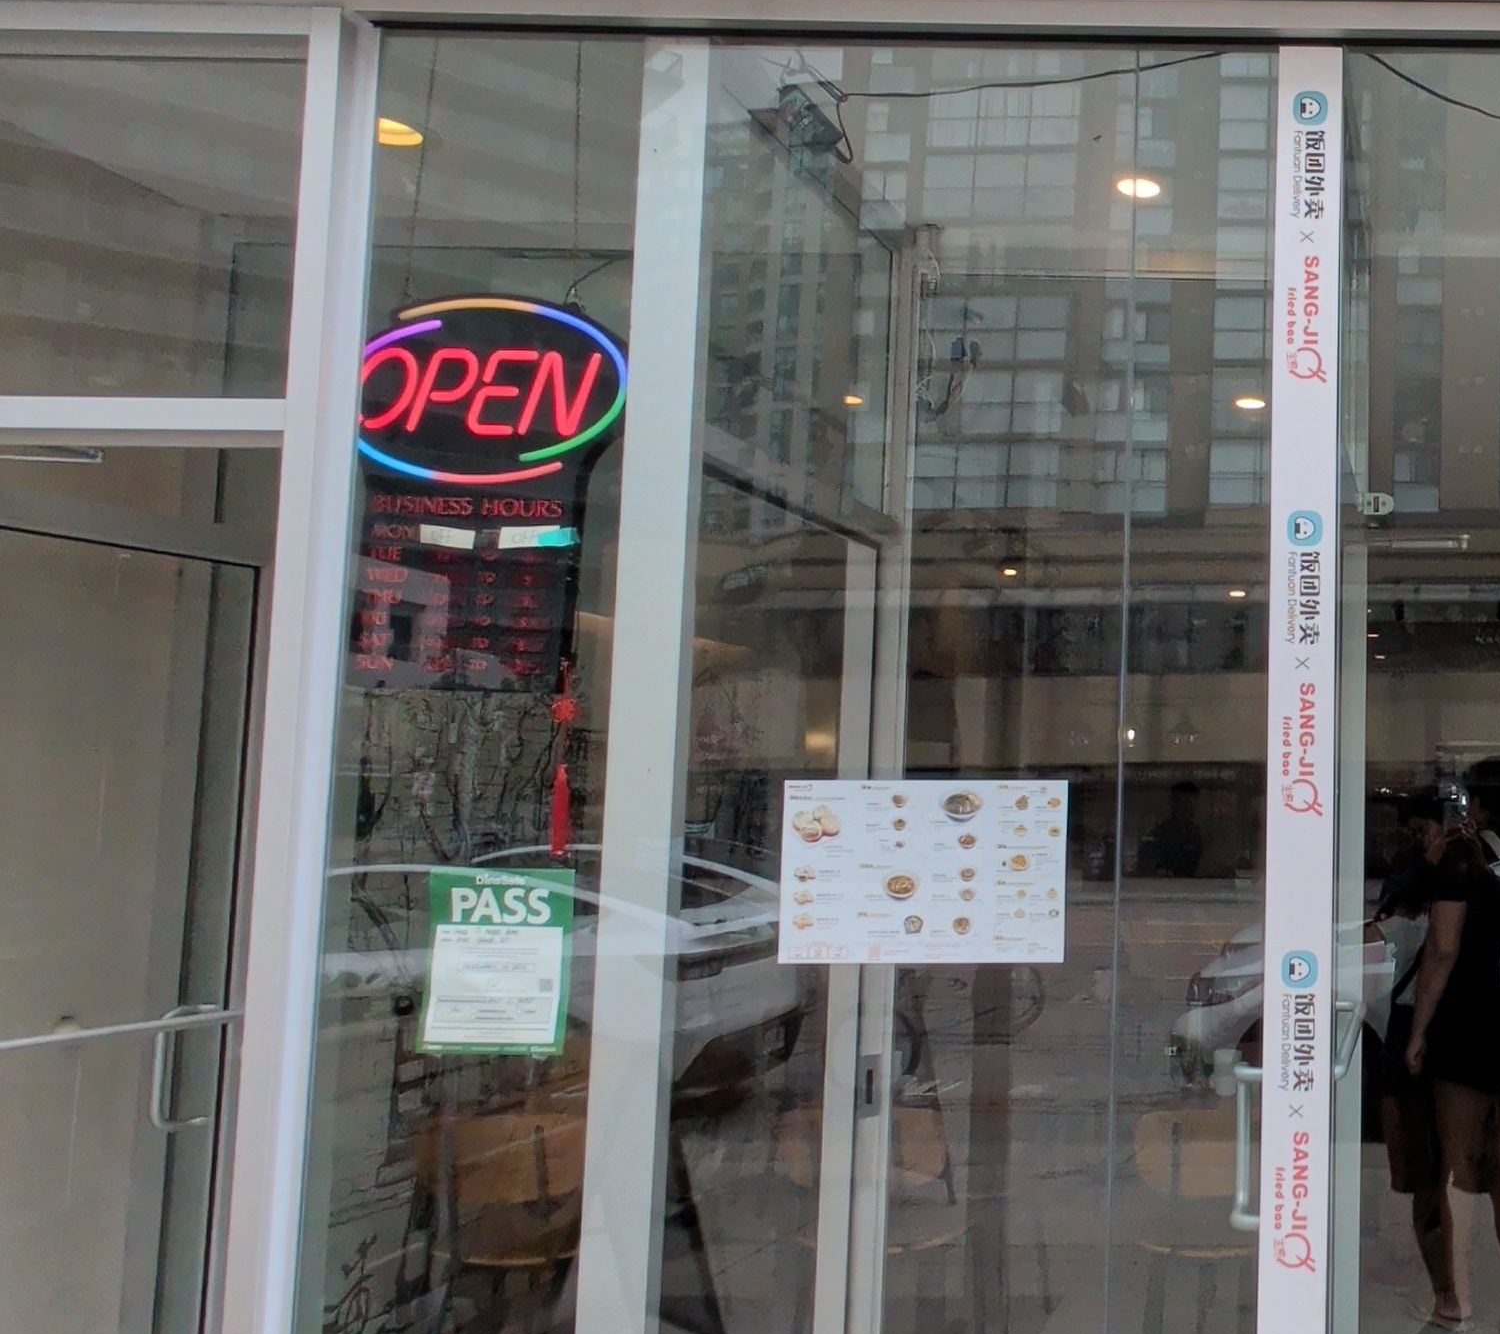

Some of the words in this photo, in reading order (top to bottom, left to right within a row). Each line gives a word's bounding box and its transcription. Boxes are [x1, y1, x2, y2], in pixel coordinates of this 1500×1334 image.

[1292, 130, 1301, 173] Fantuan
[1304, 130, 1325, 219] 饭团外卖
[1289, 175, 1301, 219] Delivery
[1287, 287, 1297, 316] fried
[1303, 255, 1320, 345] SANG-JI
[1286, 320, 1296, 345] bao
[358, 346, 602, 437] OPEN
[372, 495, 474, 516] BUSINESS
[480, 497, 563, 518] HOURS
[1288, 552, 1298, 596] Fantuan
[1300, 551, 1321, 645] 饭团外卖
[1284, 599, 1298, 644] Delivery
[1282, 716, 1293, 746] fried
[1299, 683, 1315, 776] SANG-JI
[1282, 750, 1292, 776] bao
[451, 886, 552, 925] PASS
[1281, 994, 1292, 1040] Fantuan
[1293, 993, 1315, 1092] 饭团外卖
[1277, 1043, 1292, 1091] Delivery
[1275, 1167, 1286, 1199] fried
[1292, 1131, 1309, 1229] SANG-JI
[1274, 1202, 1285, 1230] bao
